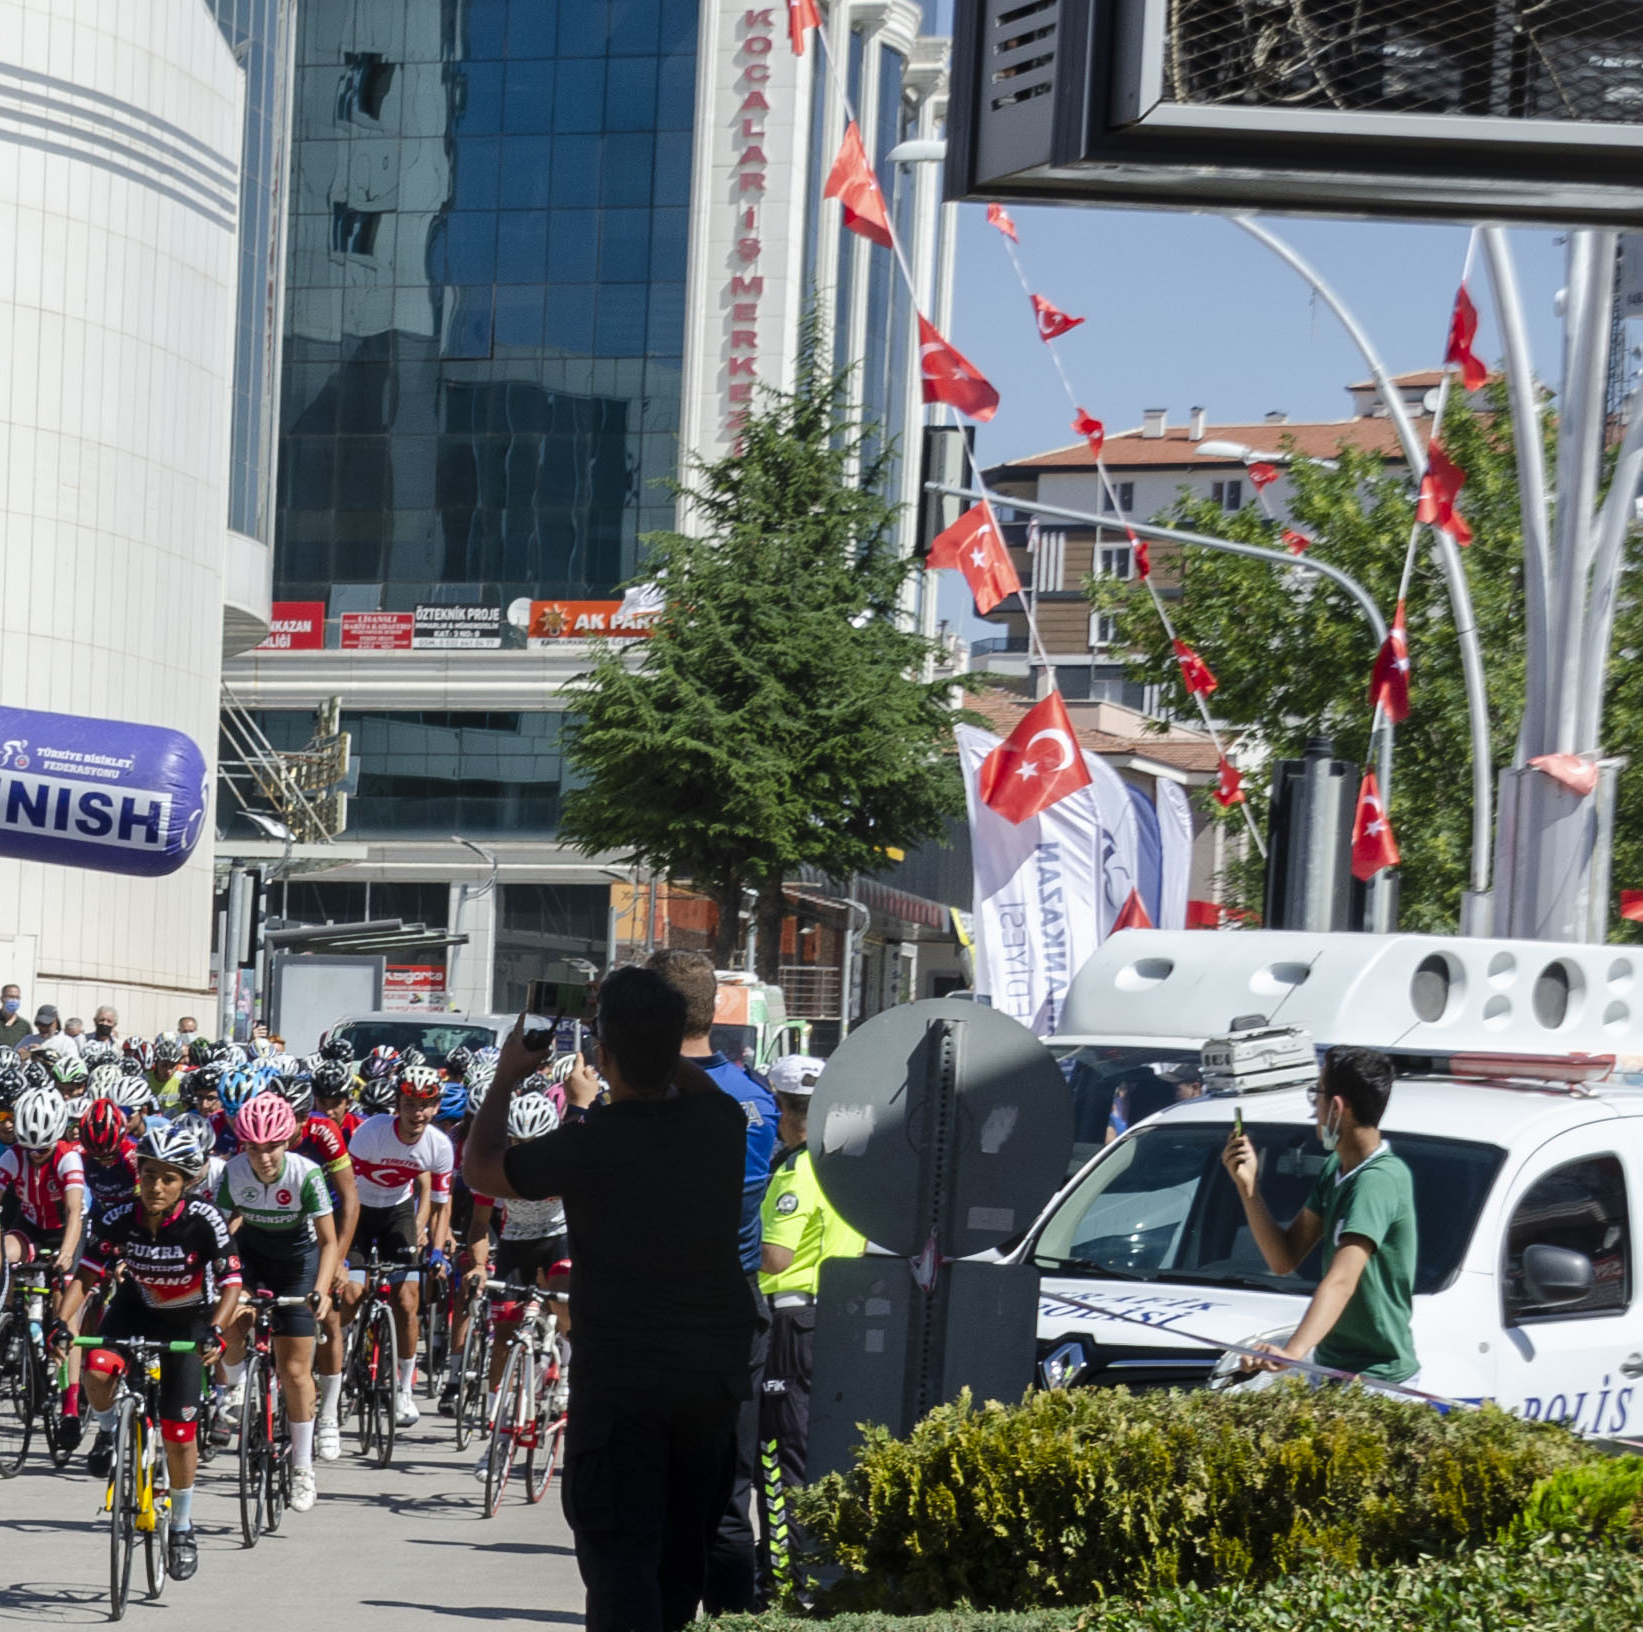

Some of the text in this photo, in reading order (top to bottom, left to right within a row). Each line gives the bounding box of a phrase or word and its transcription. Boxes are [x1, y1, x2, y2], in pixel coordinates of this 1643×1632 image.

[738, 8, 775, 191] KOCALAR
[467, 608, 500, 620] PROJE
[574, 614, 605, 629] AK
[36, 747, 132, 769] TÜRKİYE BİSİKLET
[43, 761, 120, 780] FEDERASYONU
[310, 1124, 340, 1155] KONYA
[188, 1200, 230, 1249] ÇUMRA
